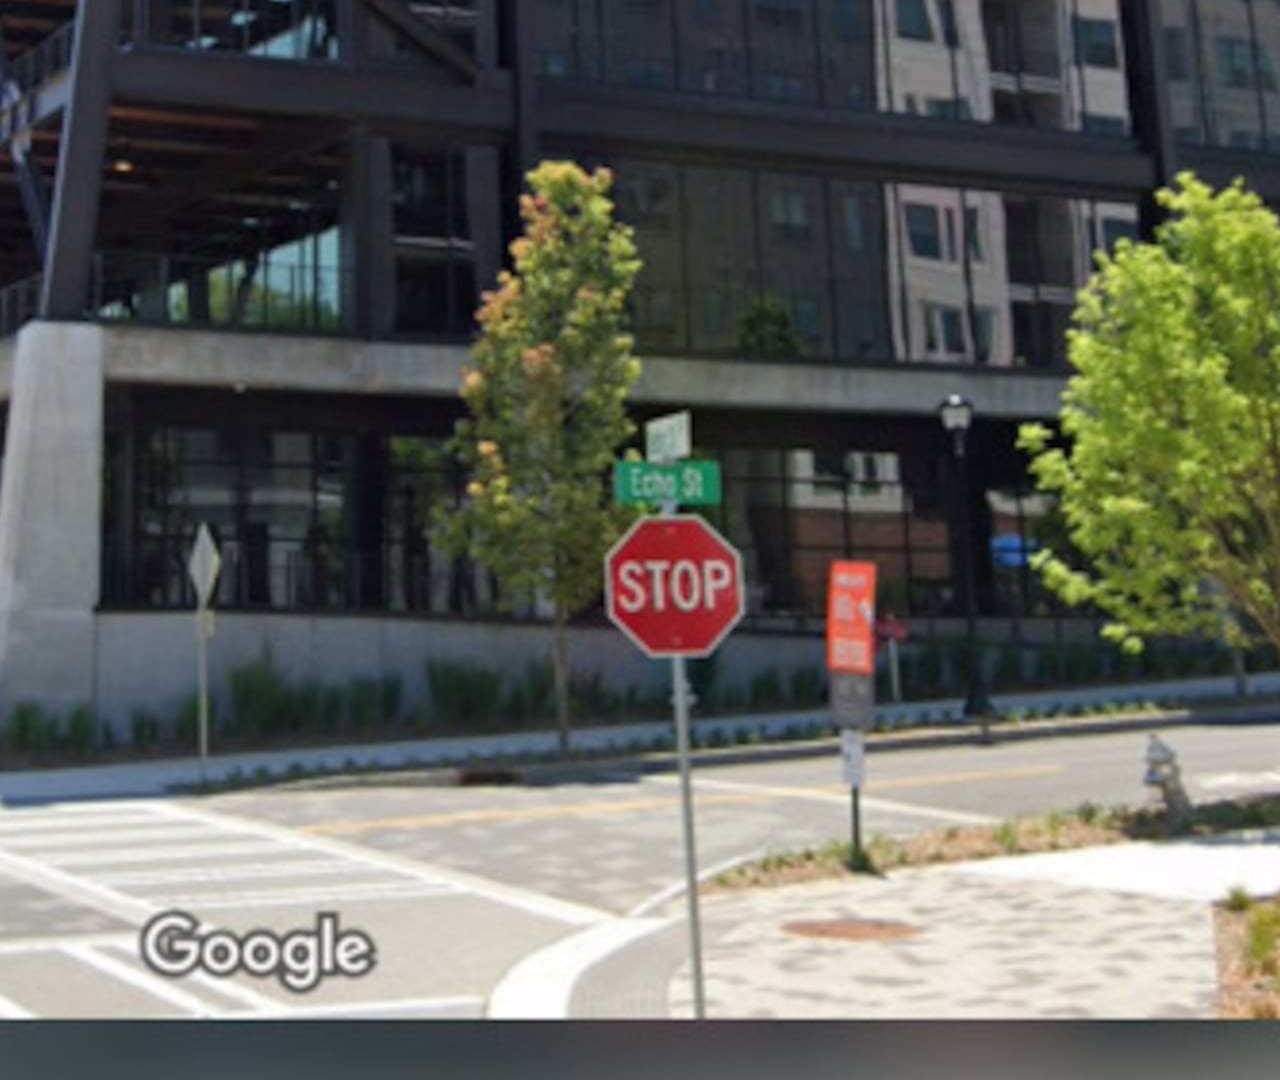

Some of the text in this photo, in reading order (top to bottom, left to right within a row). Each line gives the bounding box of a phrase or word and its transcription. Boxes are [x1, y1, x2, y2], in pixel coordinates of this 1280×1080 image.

[630, 467, 704, 497] Echo St
[619, 560, 732, 612] STOP
